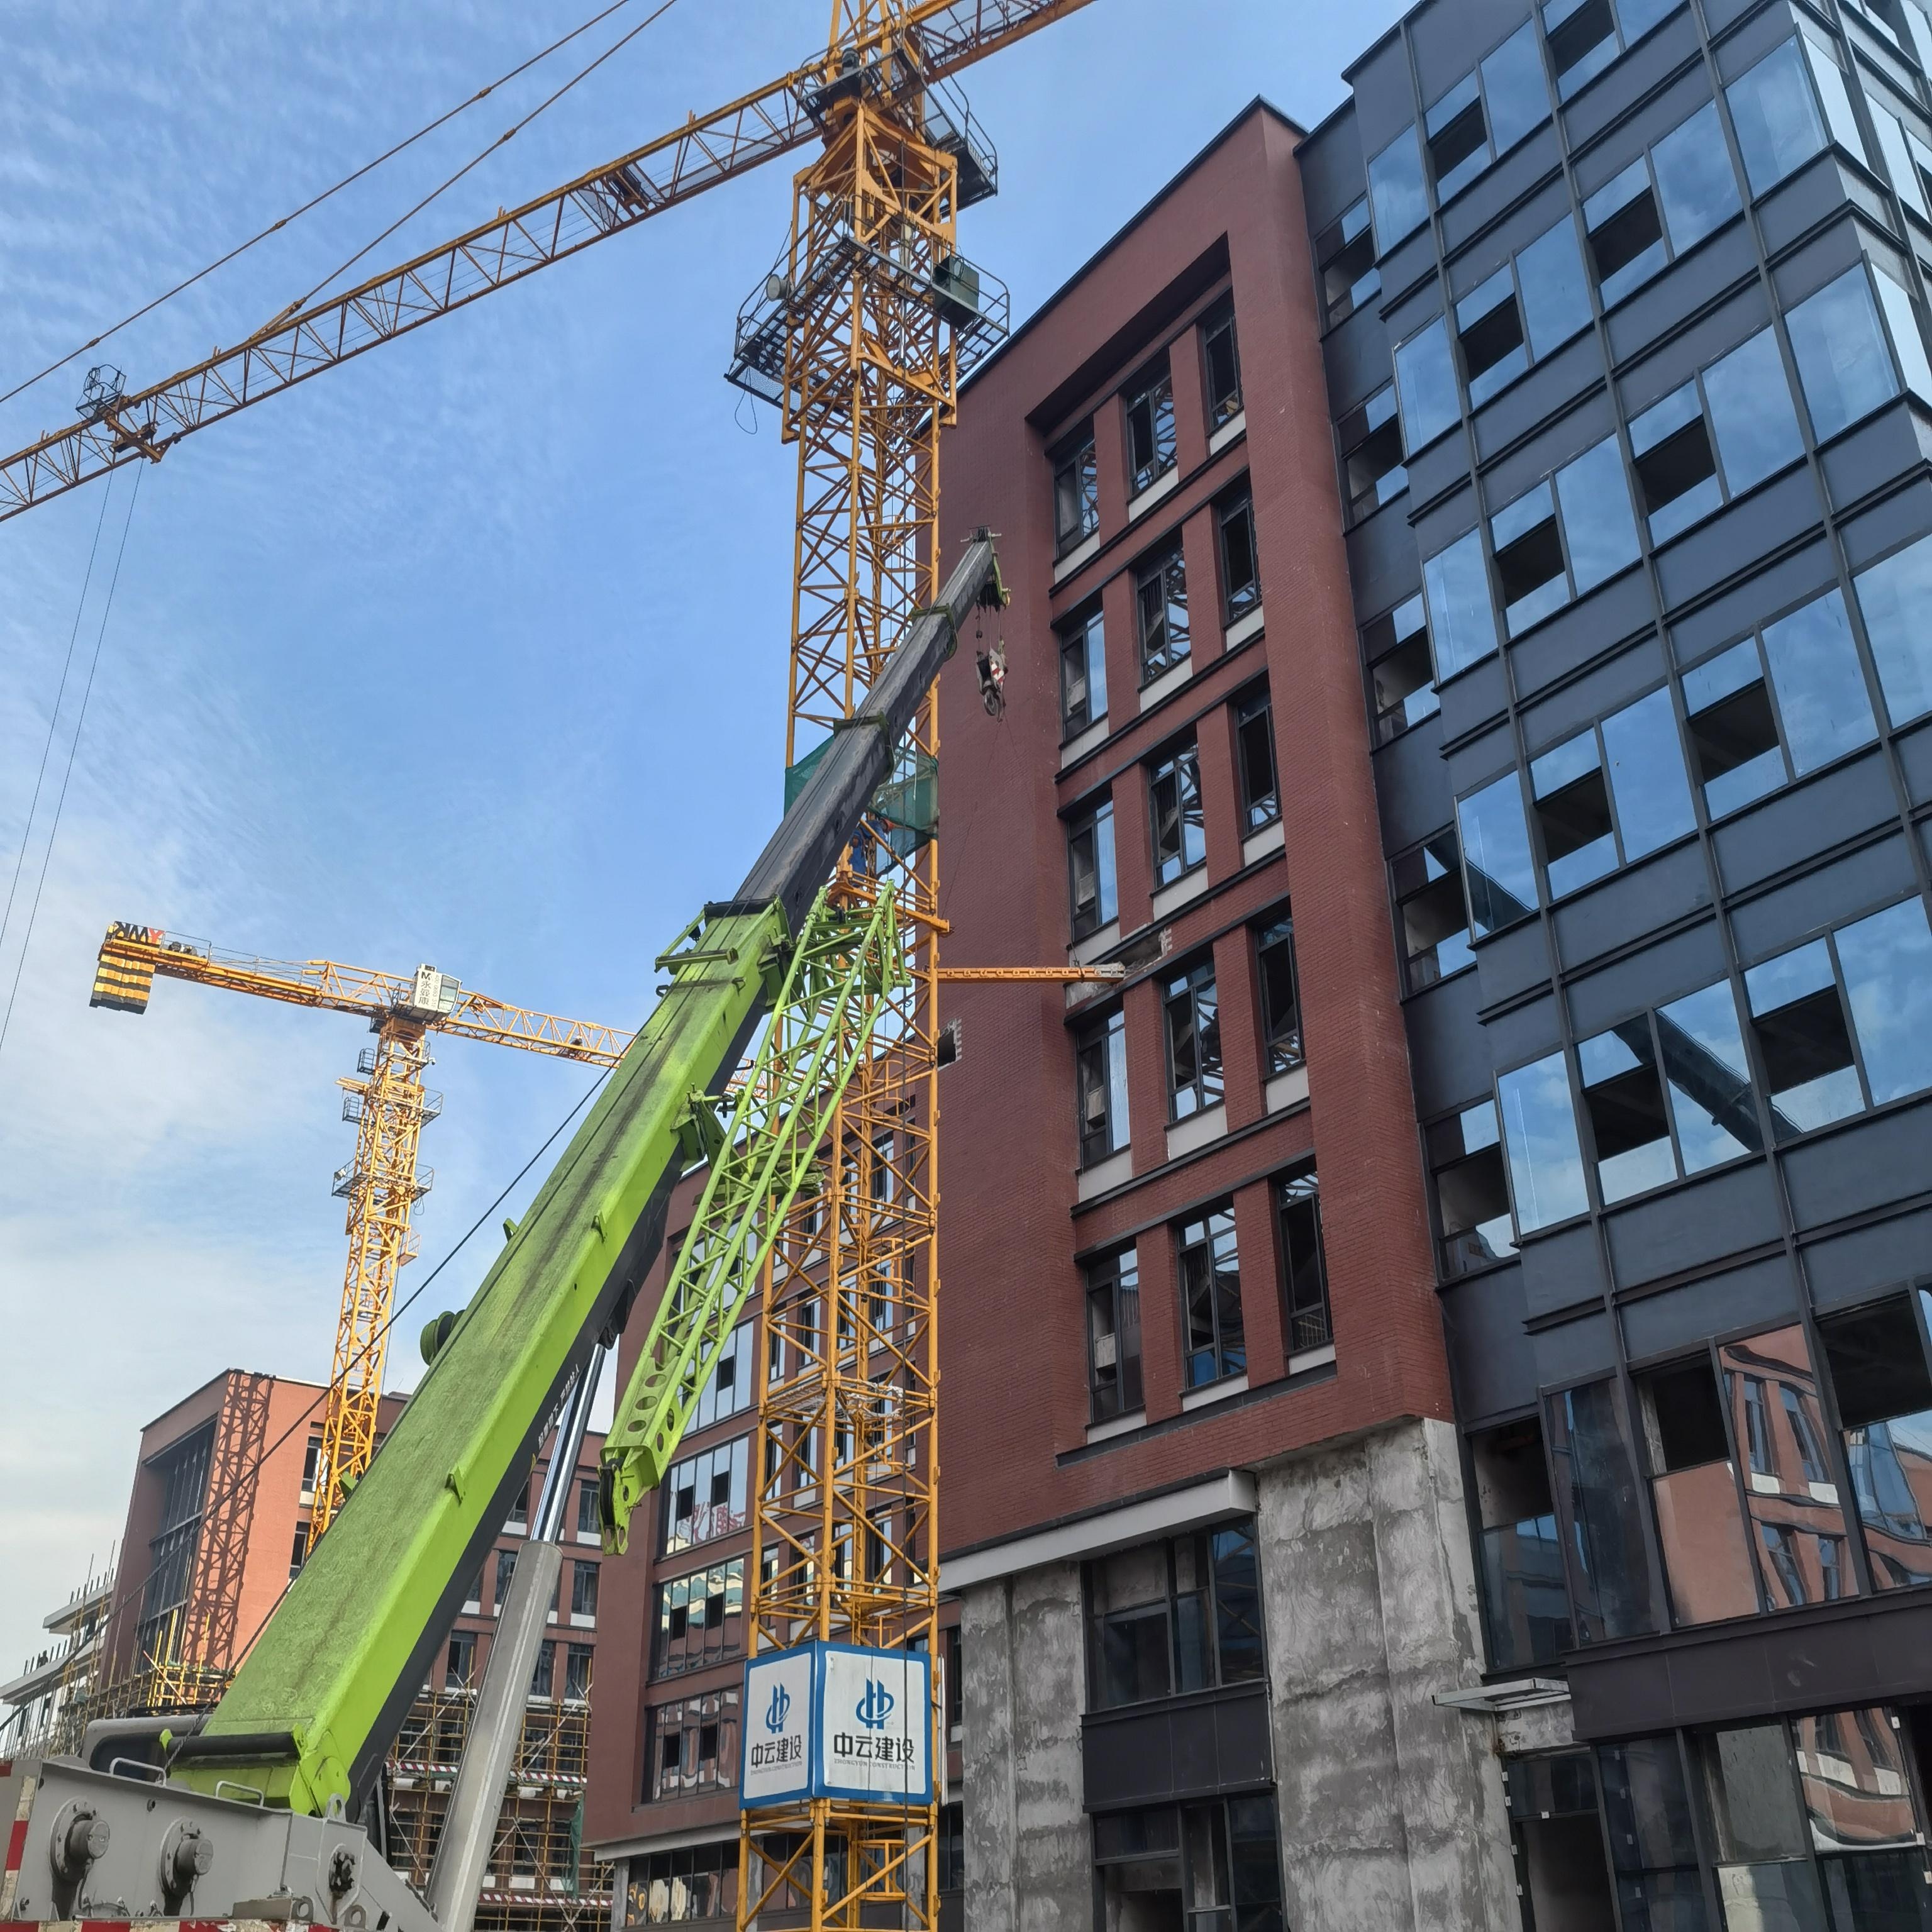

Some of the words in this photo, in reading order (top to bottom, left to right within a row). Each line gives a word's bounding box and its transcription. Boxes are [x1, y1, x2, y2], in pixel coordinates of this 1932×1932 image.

[751, 1735, 802, 1768] 中云建设
[834, 1732, 914, 1763] 中云建设
